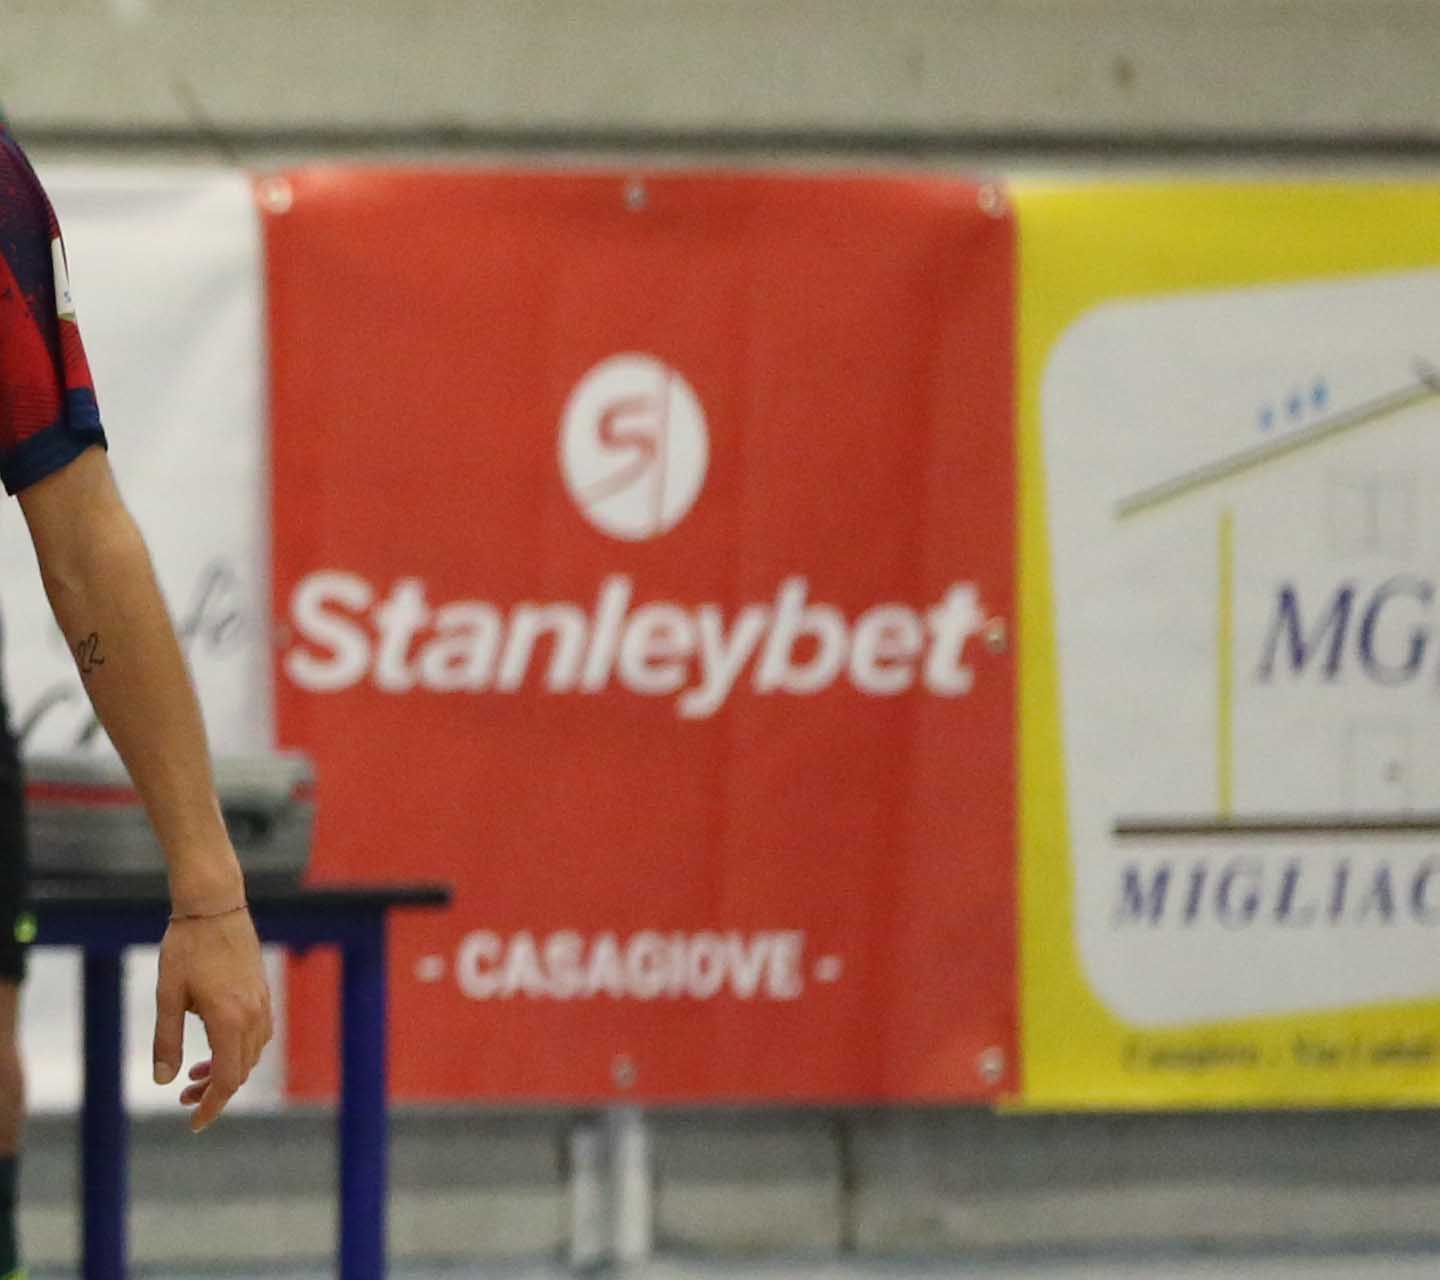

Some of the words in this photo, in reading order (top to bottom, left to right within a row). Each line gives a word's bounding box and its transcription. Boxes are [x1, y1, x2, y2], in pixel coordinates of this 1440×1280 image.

[288, 569, 987, 721] Stanleybet
[1257, 574, 1440, 687] MG
[455, 930, 803, 1001] CASAGIOVE
